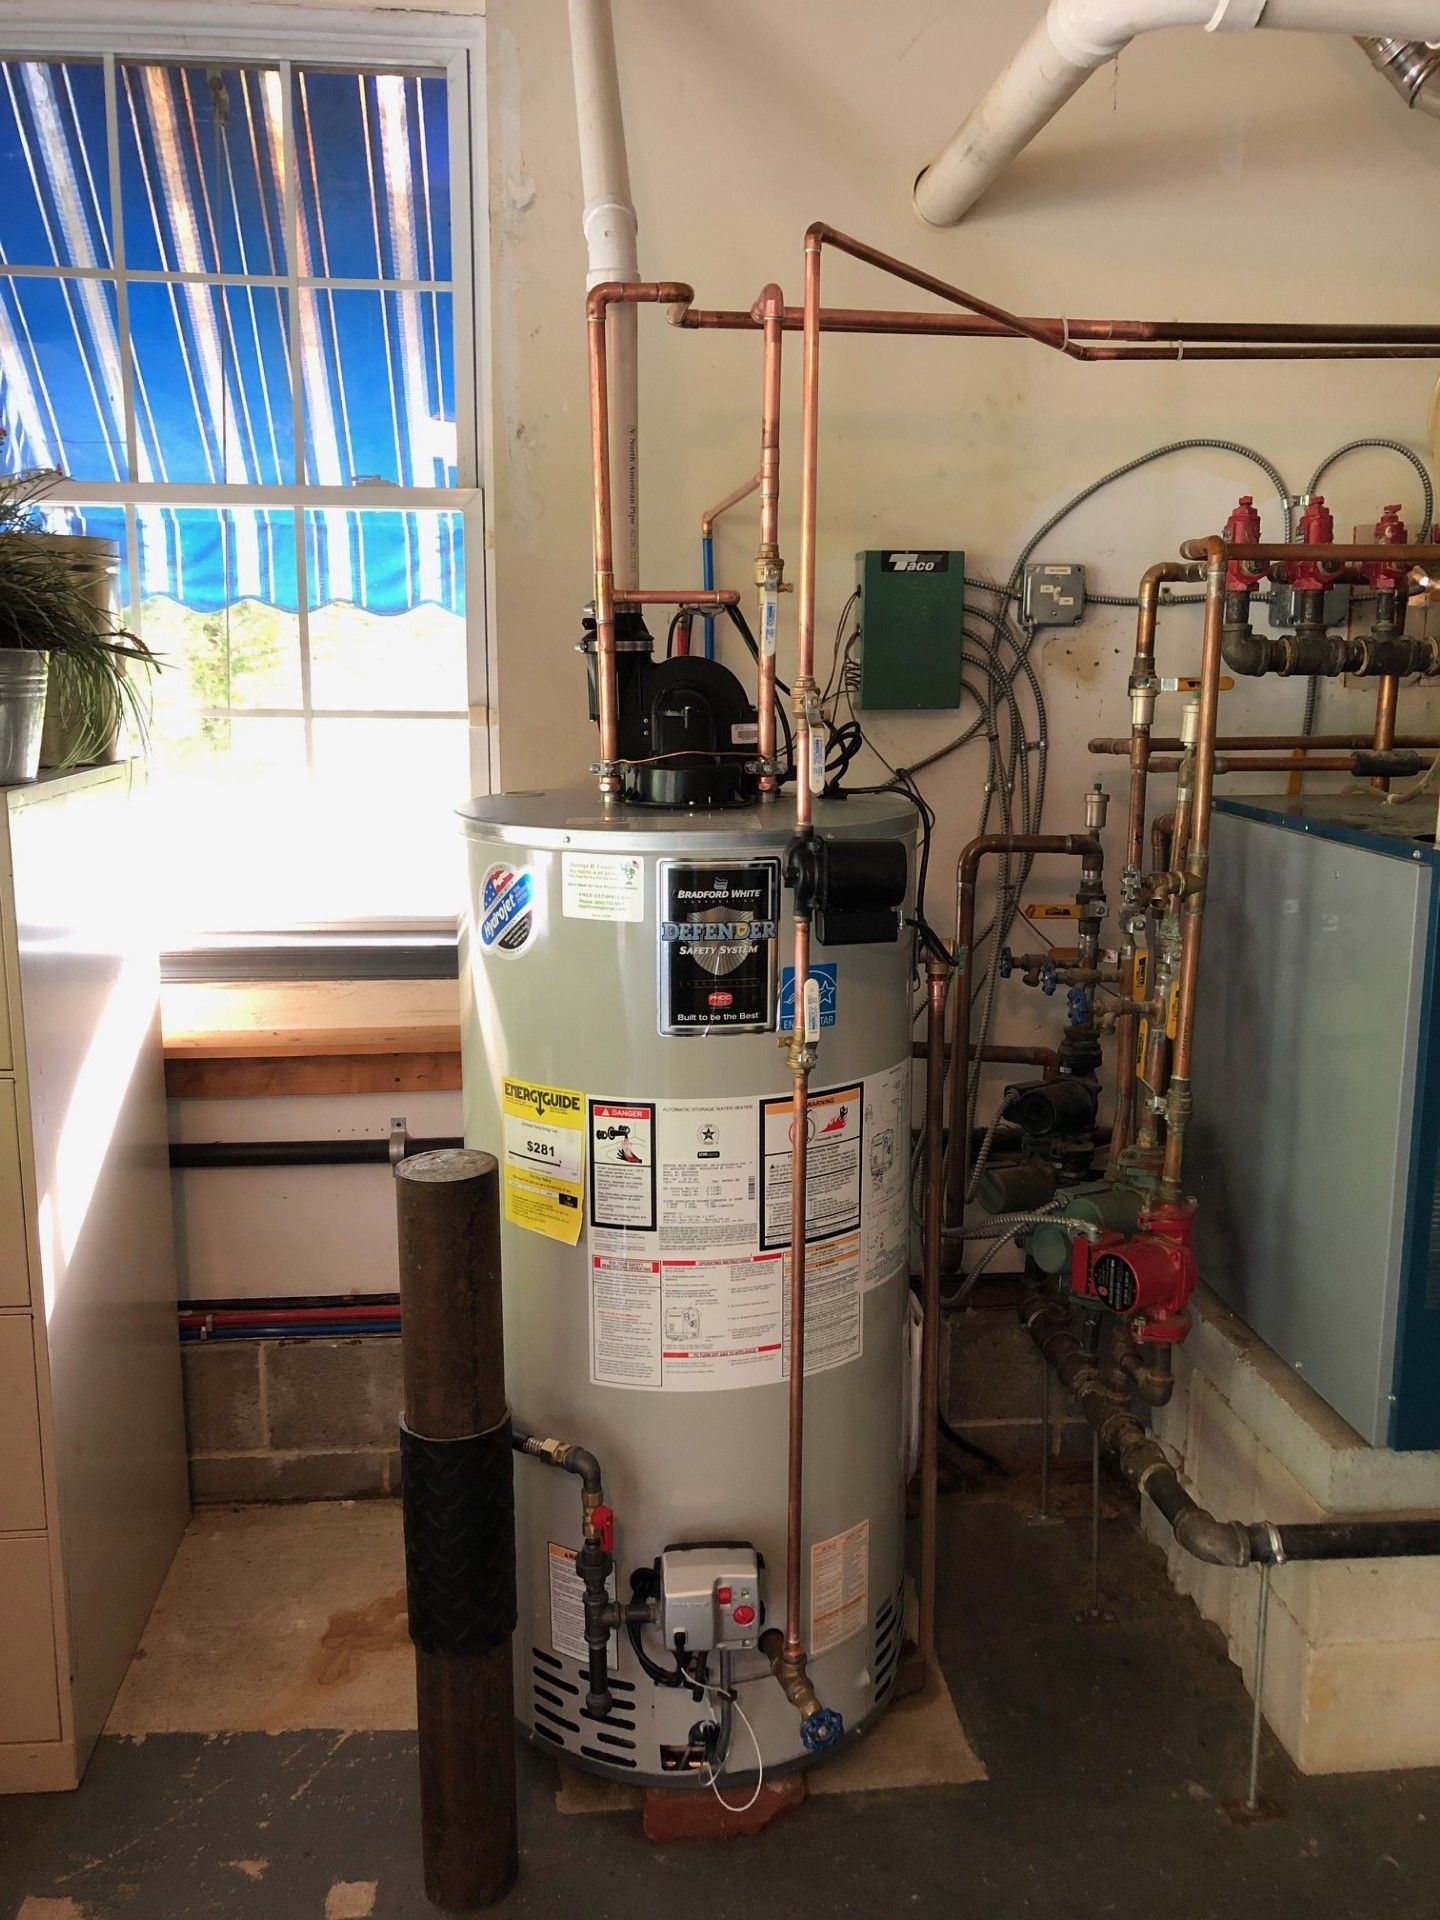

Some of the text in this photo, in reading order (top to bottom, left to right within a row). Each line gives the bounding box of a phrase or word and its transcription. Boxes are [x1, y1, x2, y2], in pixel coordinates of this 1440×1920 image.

[628, 506, 636, 524] Pipe
[889, 553, 936, 571] Taco
[678, 890, 760, 899] BRADFORD WHITE
[484, 893, 516, 939] Hydrojet
[662, 921, 776, 941] DEFENDER
[679, 945, 758, 955] SAFETY SYSTEM
[740, 1012, 758, 1020] Best
[820, 1016, 834, 1026] TAR
[527, 1140, 555, 1157] $281
